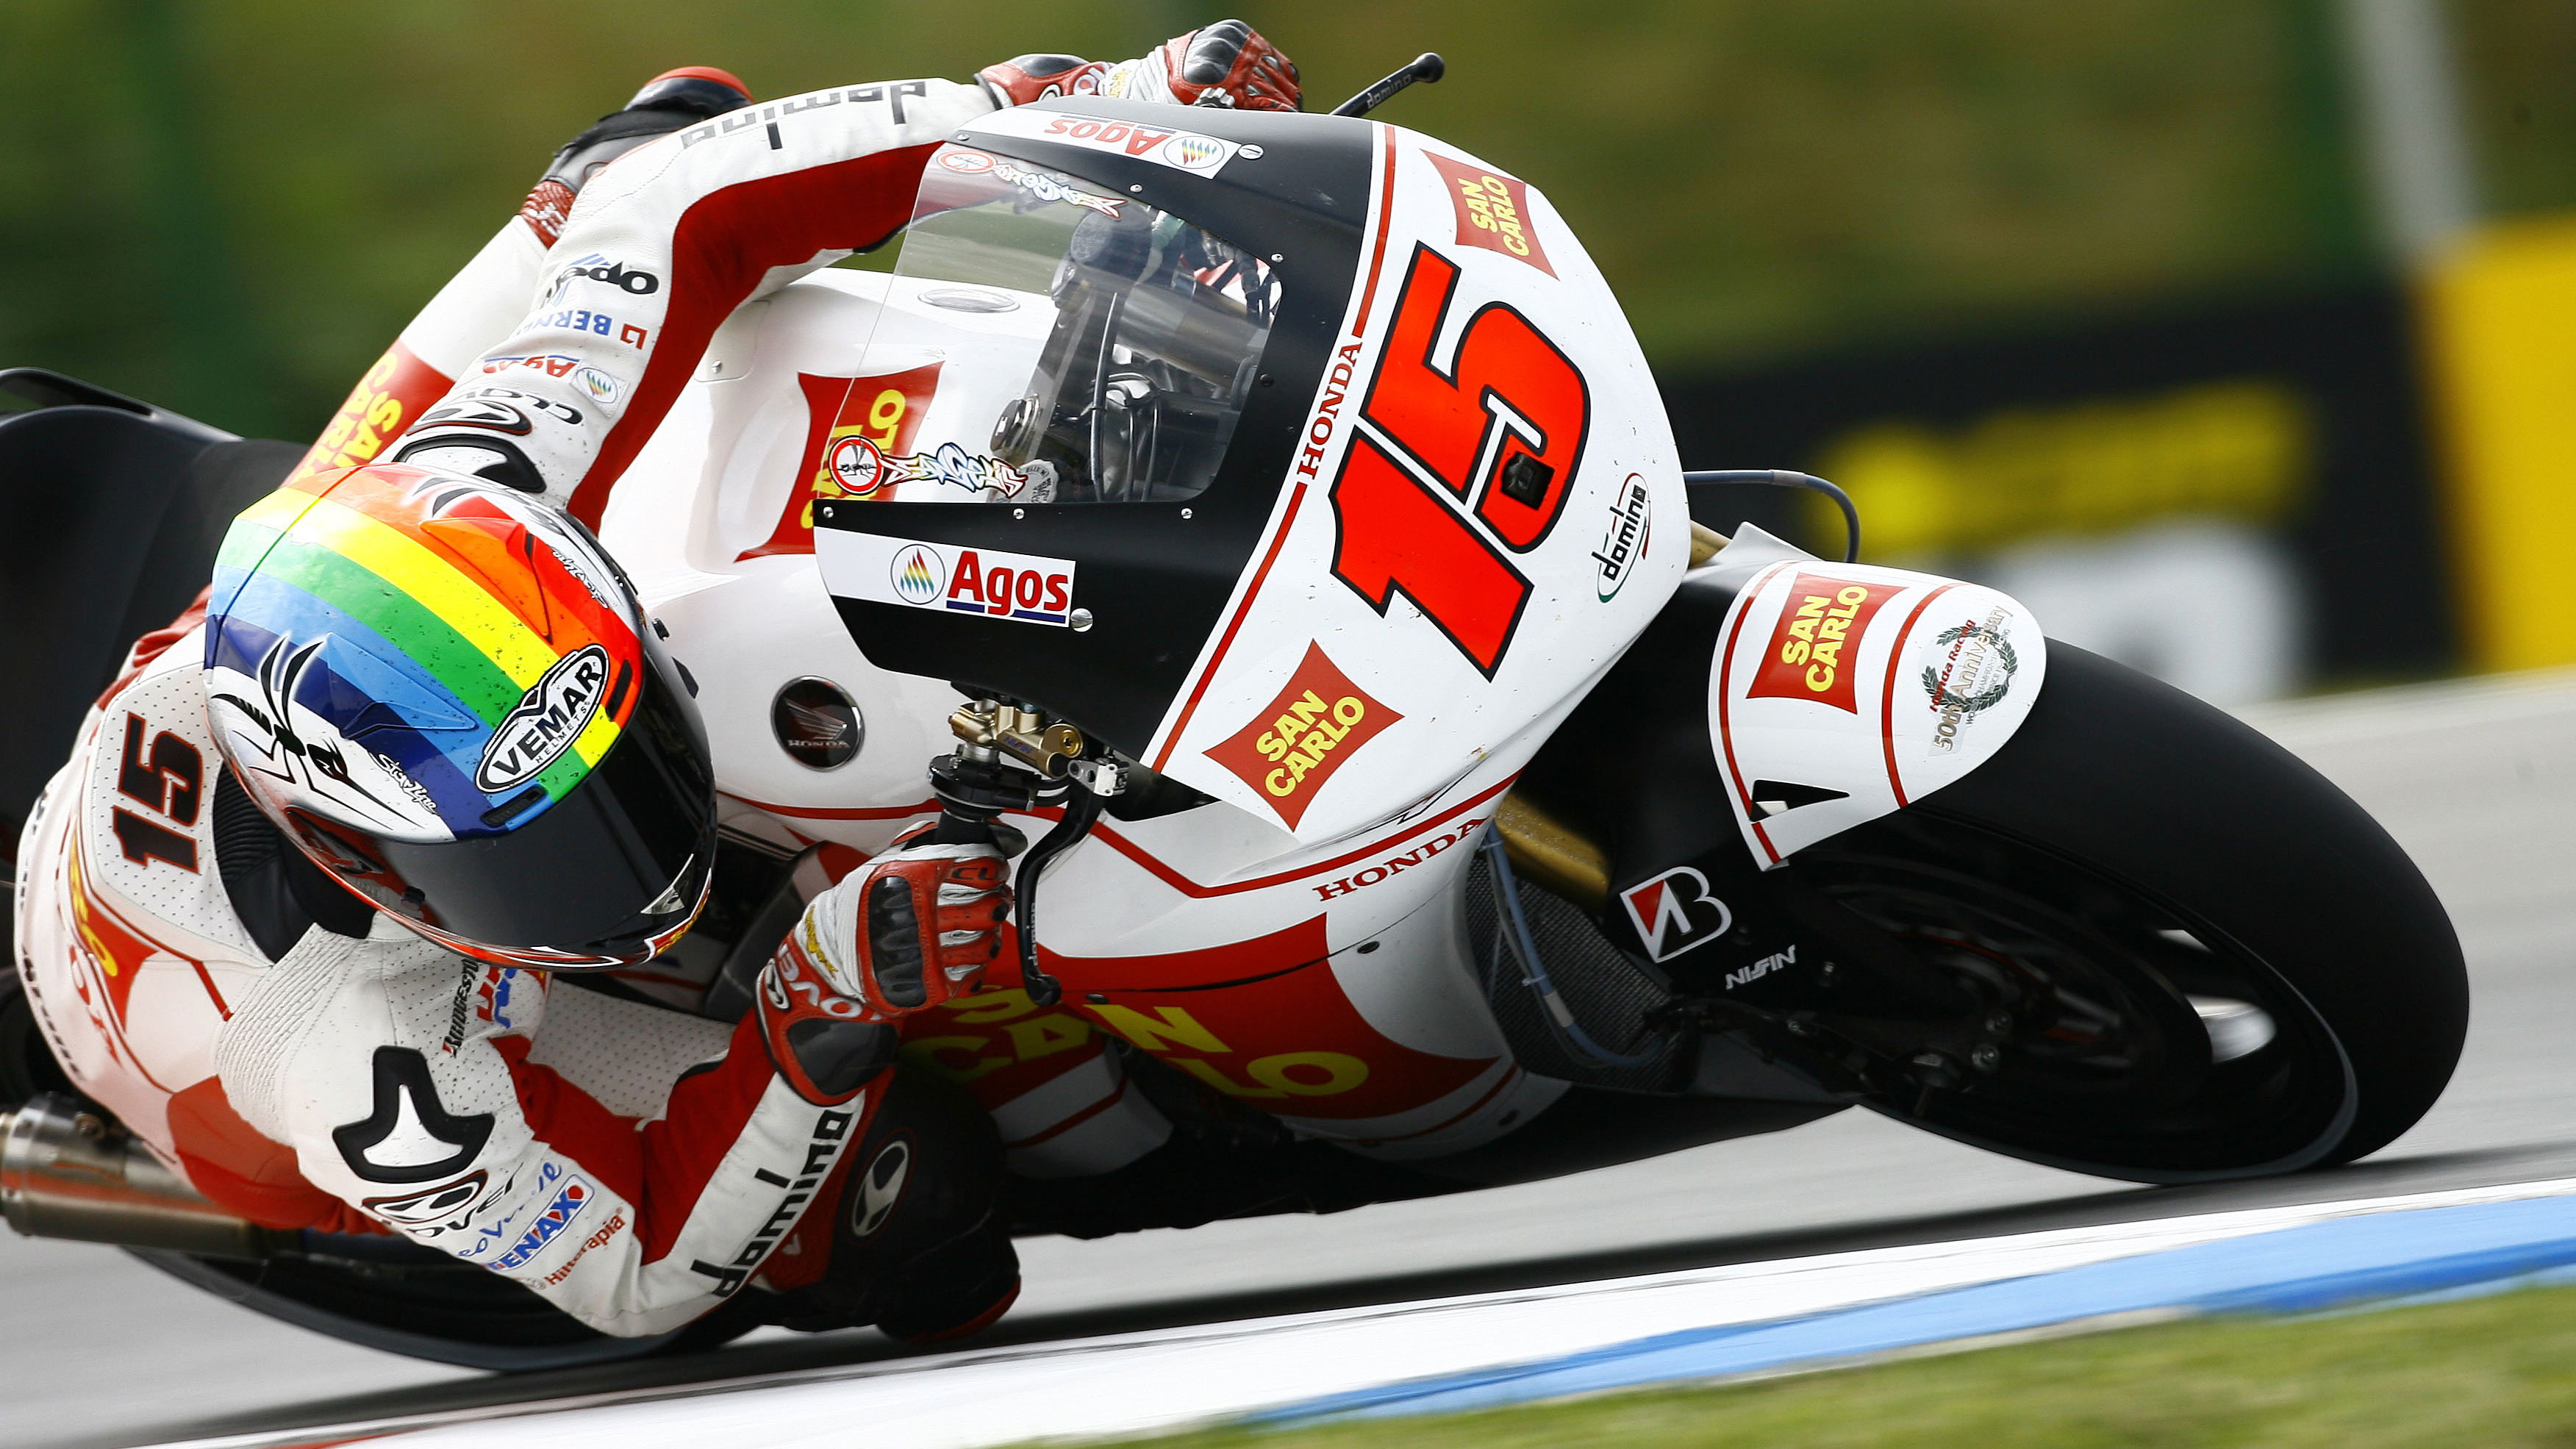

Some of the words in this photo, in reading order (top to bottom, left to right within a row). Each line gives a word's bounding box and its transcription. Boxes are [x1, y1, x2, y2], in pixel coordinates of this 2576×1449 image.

[681, 81, 926, 150] domino
[1367, 74, 1412, 109] domino
[1044, 119, 1171, 156] Agos
[1458, 178, 1496, 233] SAN
[1481, 175, 1530, 256] CARLO
[1297, 341, 1362, 480] HONDA
[1328, 240, 1591, 681] 15
[1591, 484, 1646, 582] domino
[947, 550, 1069, 615] Agos
[1781, 595, 1831, 666] SAN
[1806, 586, 1869, 693] CARLO
[492, 662, 602, 776] VEMAR
[1933, 704, 1963, 751] 50th
[1950, 605, 2014, 701] Anniversary
[535, 704, 588, 764] HELMETS
[787, 739, 851, 748] HONDA
[1255, 689, 1328, 763] SAN
[1264, 696, 1366, 798] CARLO
[113, 712, 203, 873] 15
[1312, 815, 1490, 901] HONDA
[690, 1109, 853, 1297] domino
